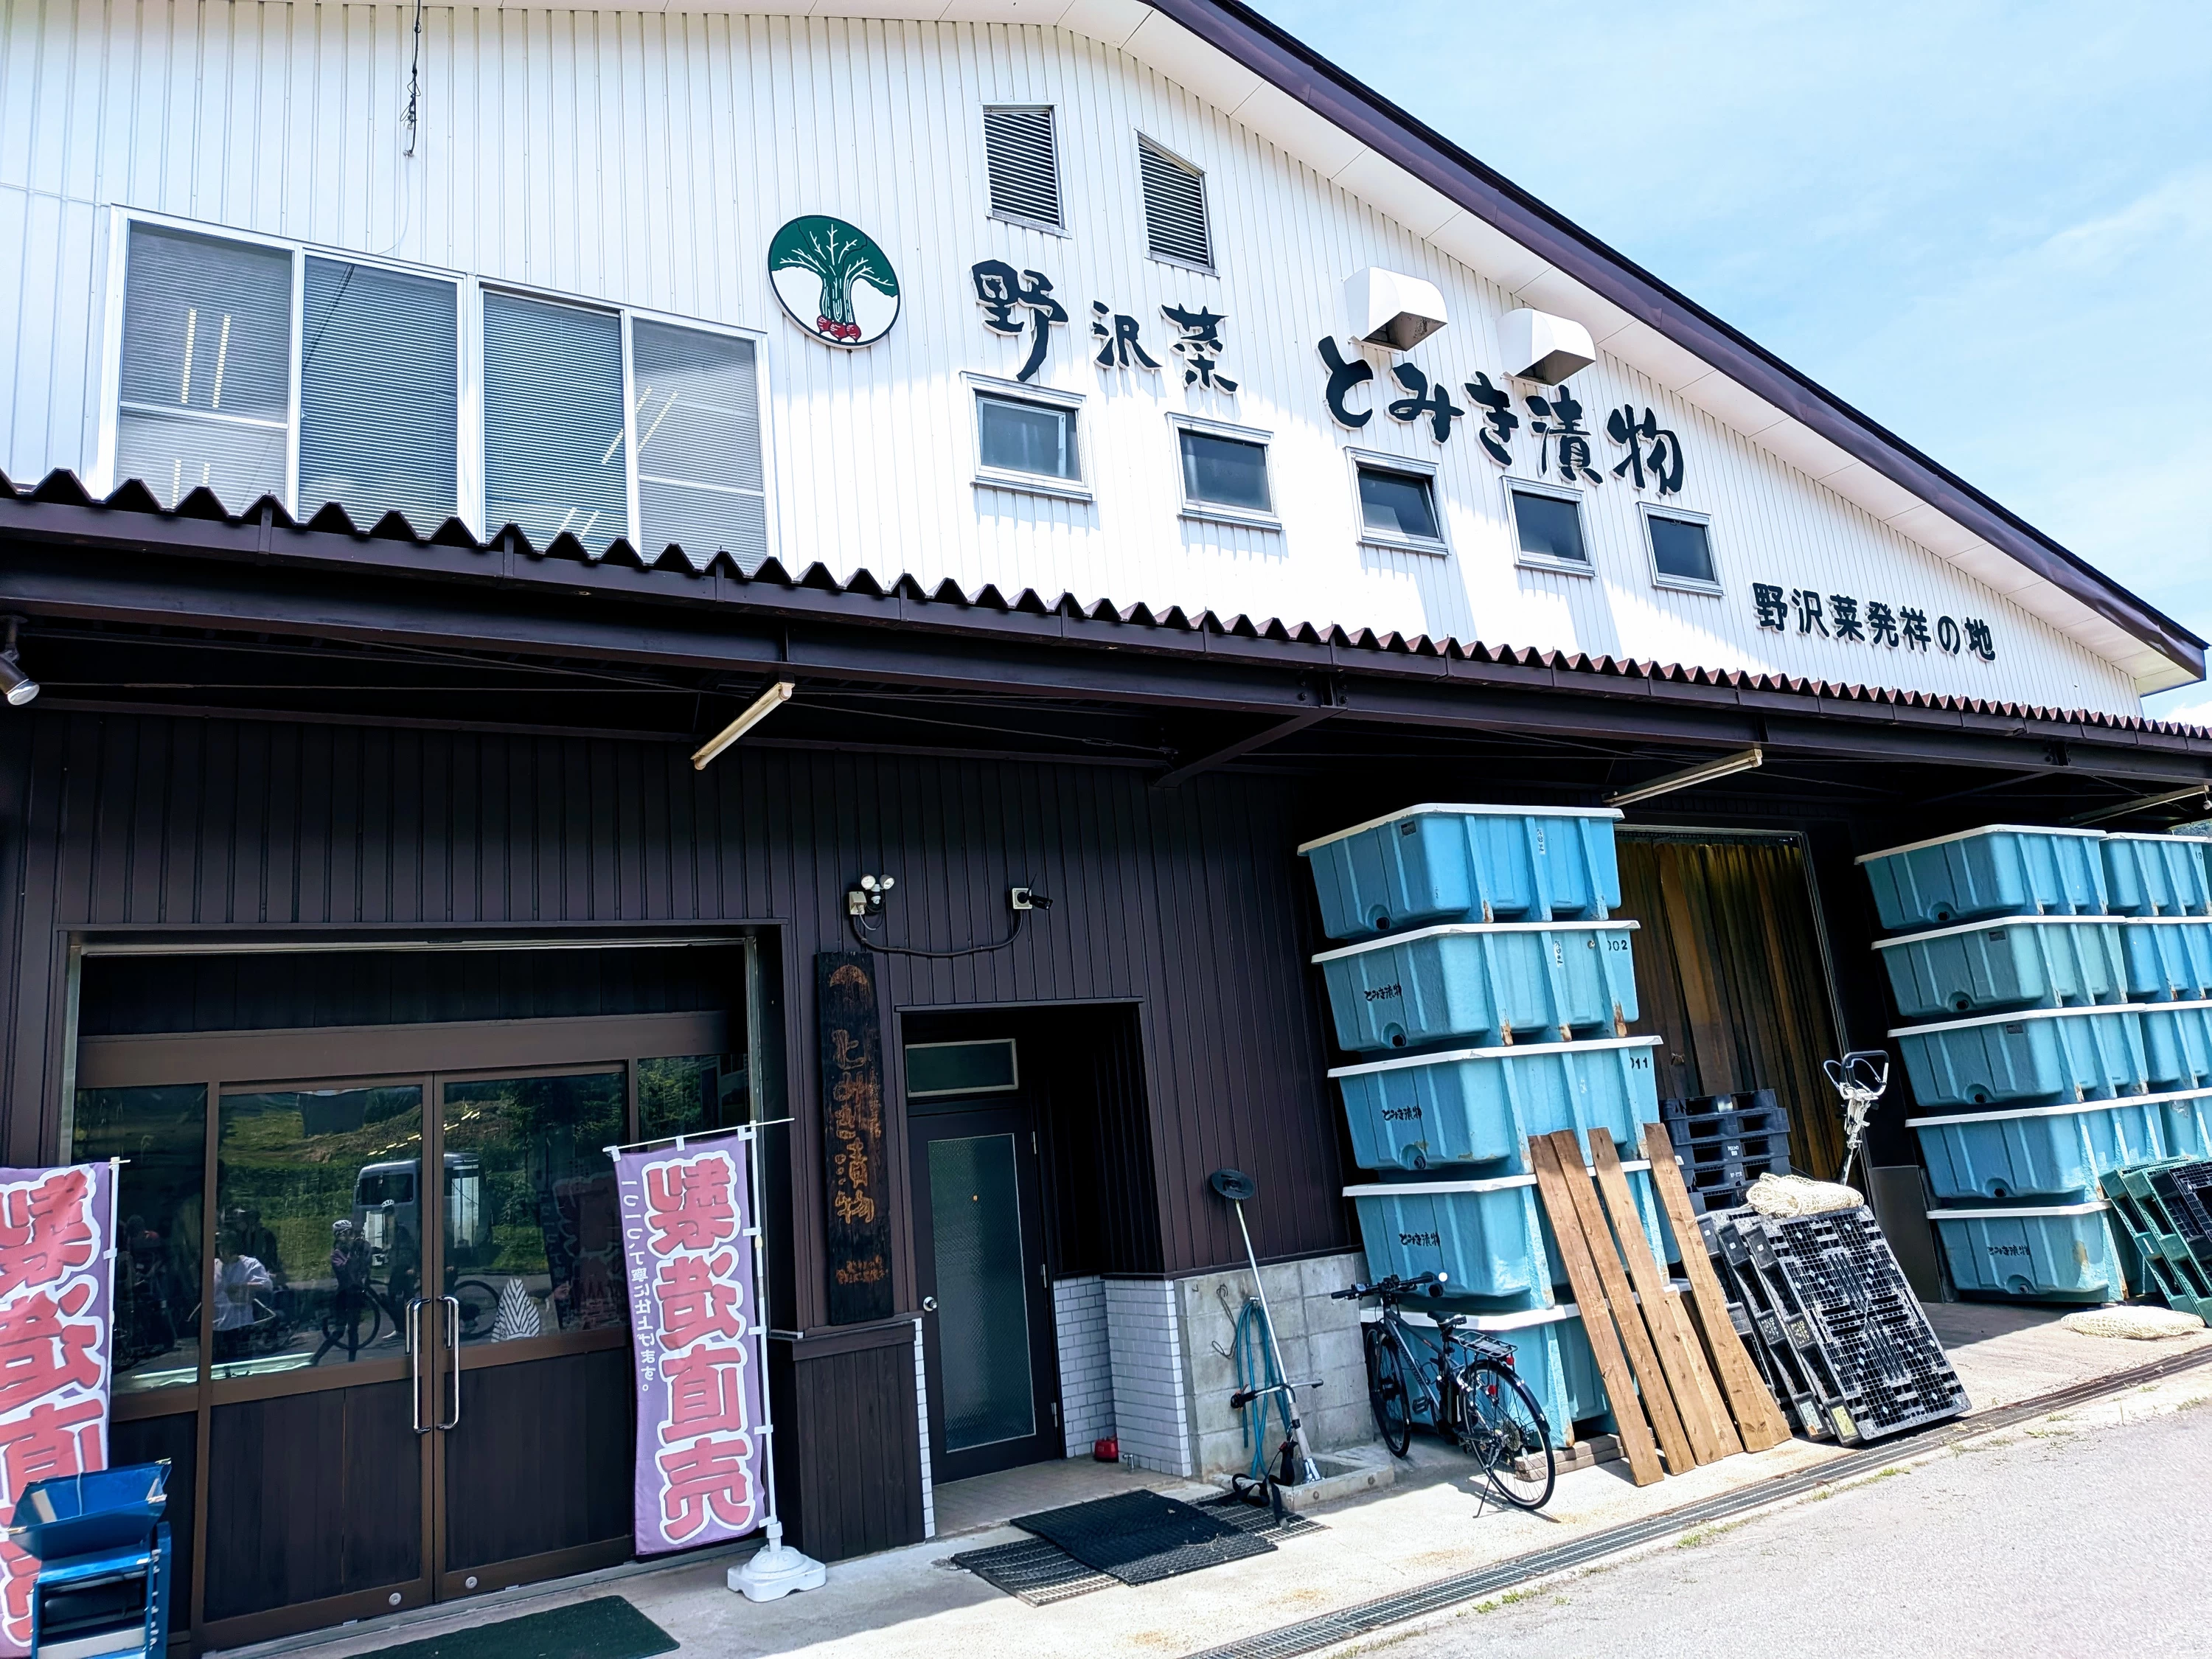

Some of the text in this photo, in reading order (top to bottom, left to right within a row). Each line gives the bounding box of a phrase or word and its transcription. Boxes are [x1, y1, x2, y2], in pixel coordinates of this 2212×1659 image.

[971, 259, 1684, 496] 野沢菜 とみき漬物
[1752, 582, 1996, 661] 野沢菜発祥の地
